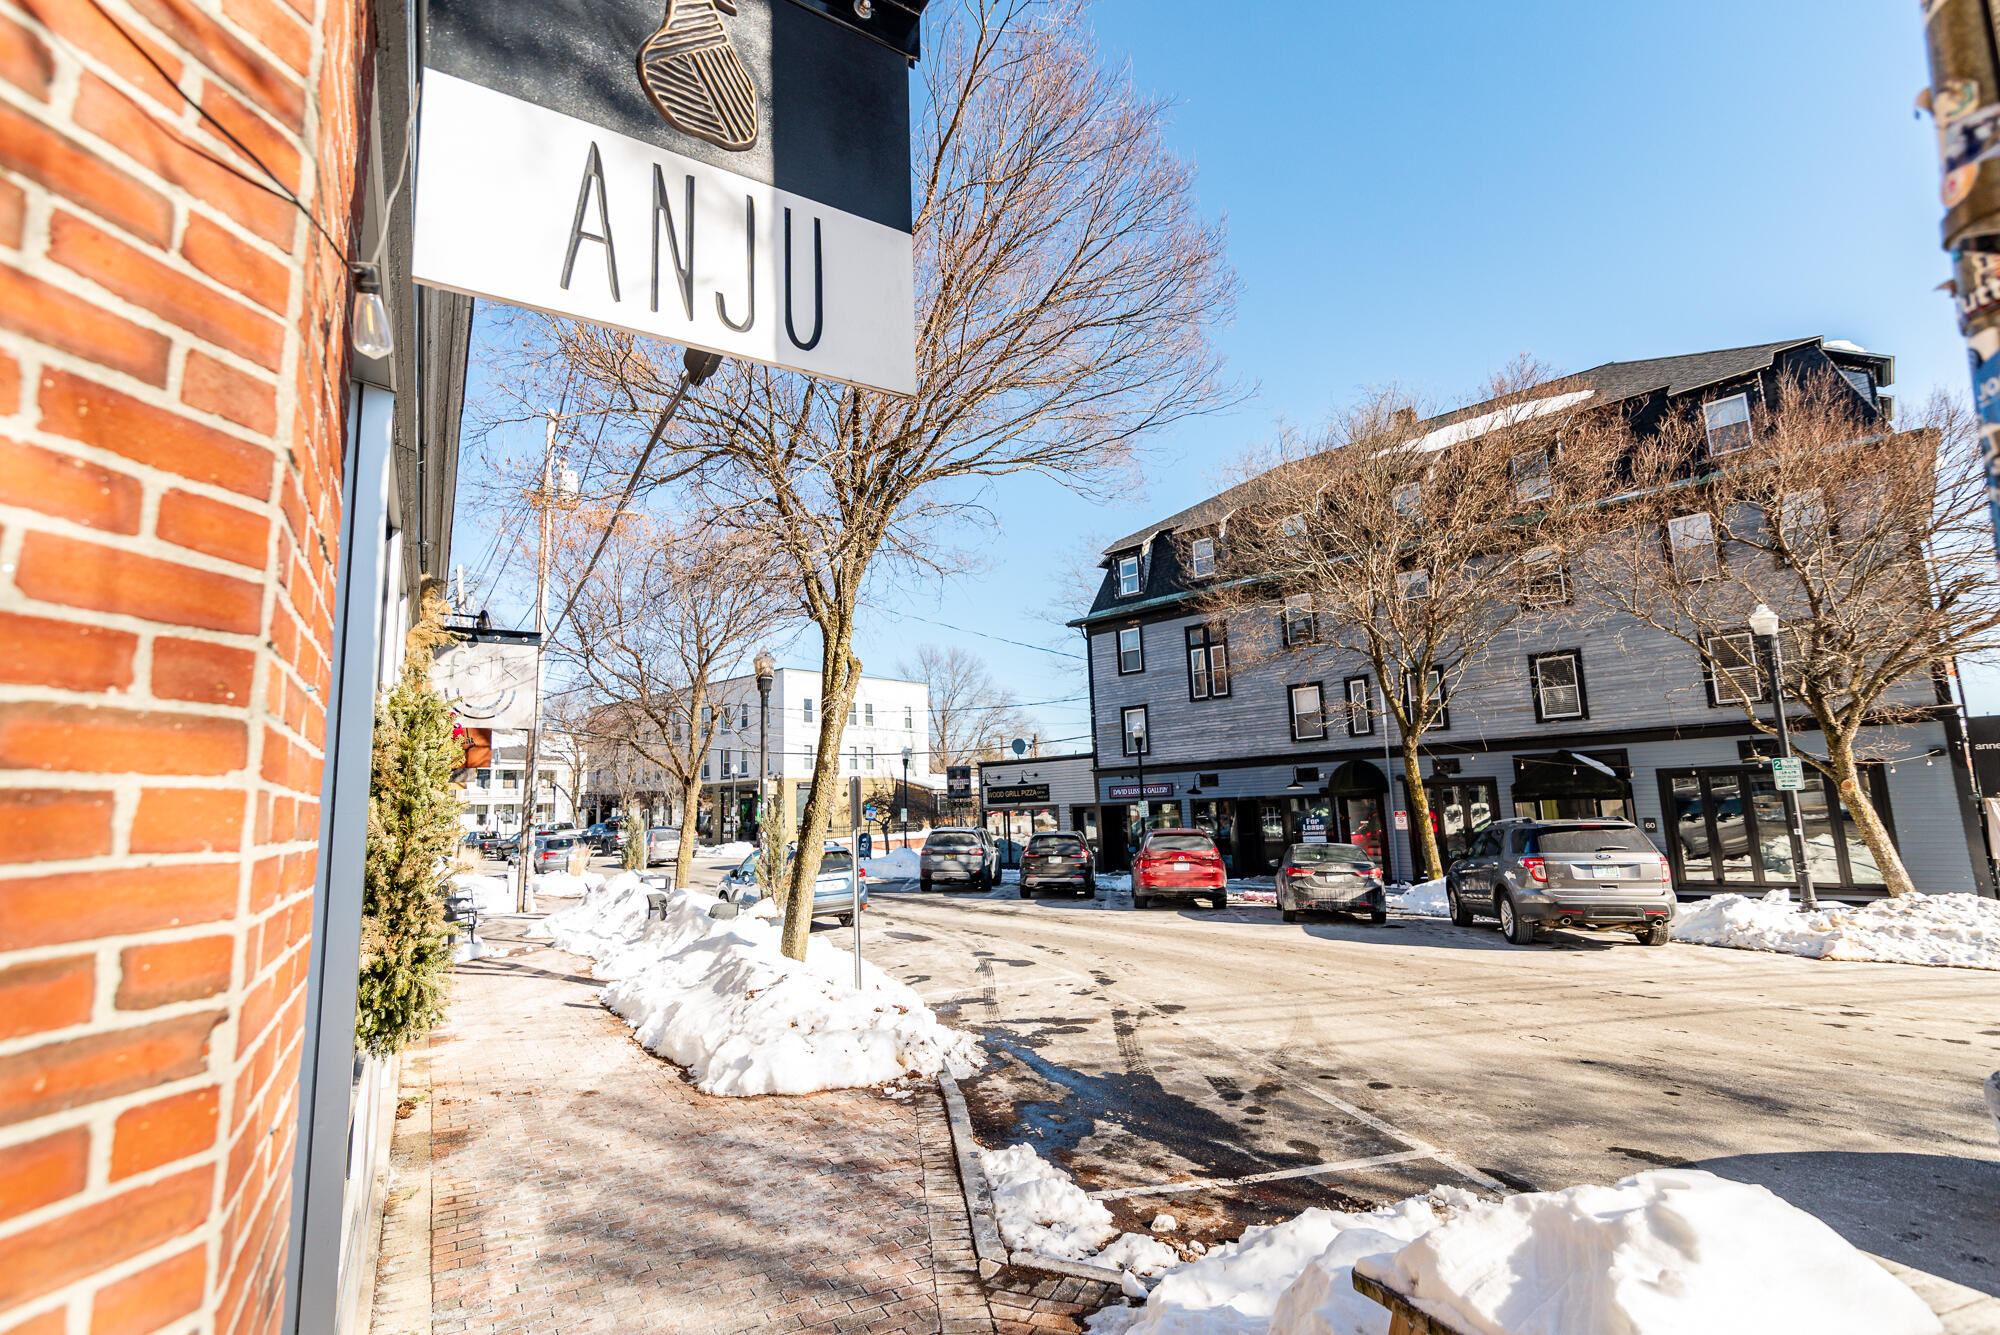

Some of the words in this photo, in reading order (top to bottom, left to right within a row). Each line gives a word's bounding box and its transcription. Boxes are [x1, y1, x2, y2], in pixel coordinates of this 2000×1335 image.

[560, 141, 824, 351] ANJU
[446, 650, 518, 681] folk
[1774, 760, 1782, 769] 2
[988, 791, 1005, 799] WOOD
[1004, 789, 1021, 798] GRILL
[1021, 789, 1037, 797] PIZZA
[1112, 788, 1128, 796] DAVID
[1128, 787, 1147, 795] LUSSR
[1147, 786, 1169, 795] GALLERY
[1305, 817, 1320, 825] For
[1645, 821, 1656, 830] 60
[1302, 823, 1325, 831] Lease
